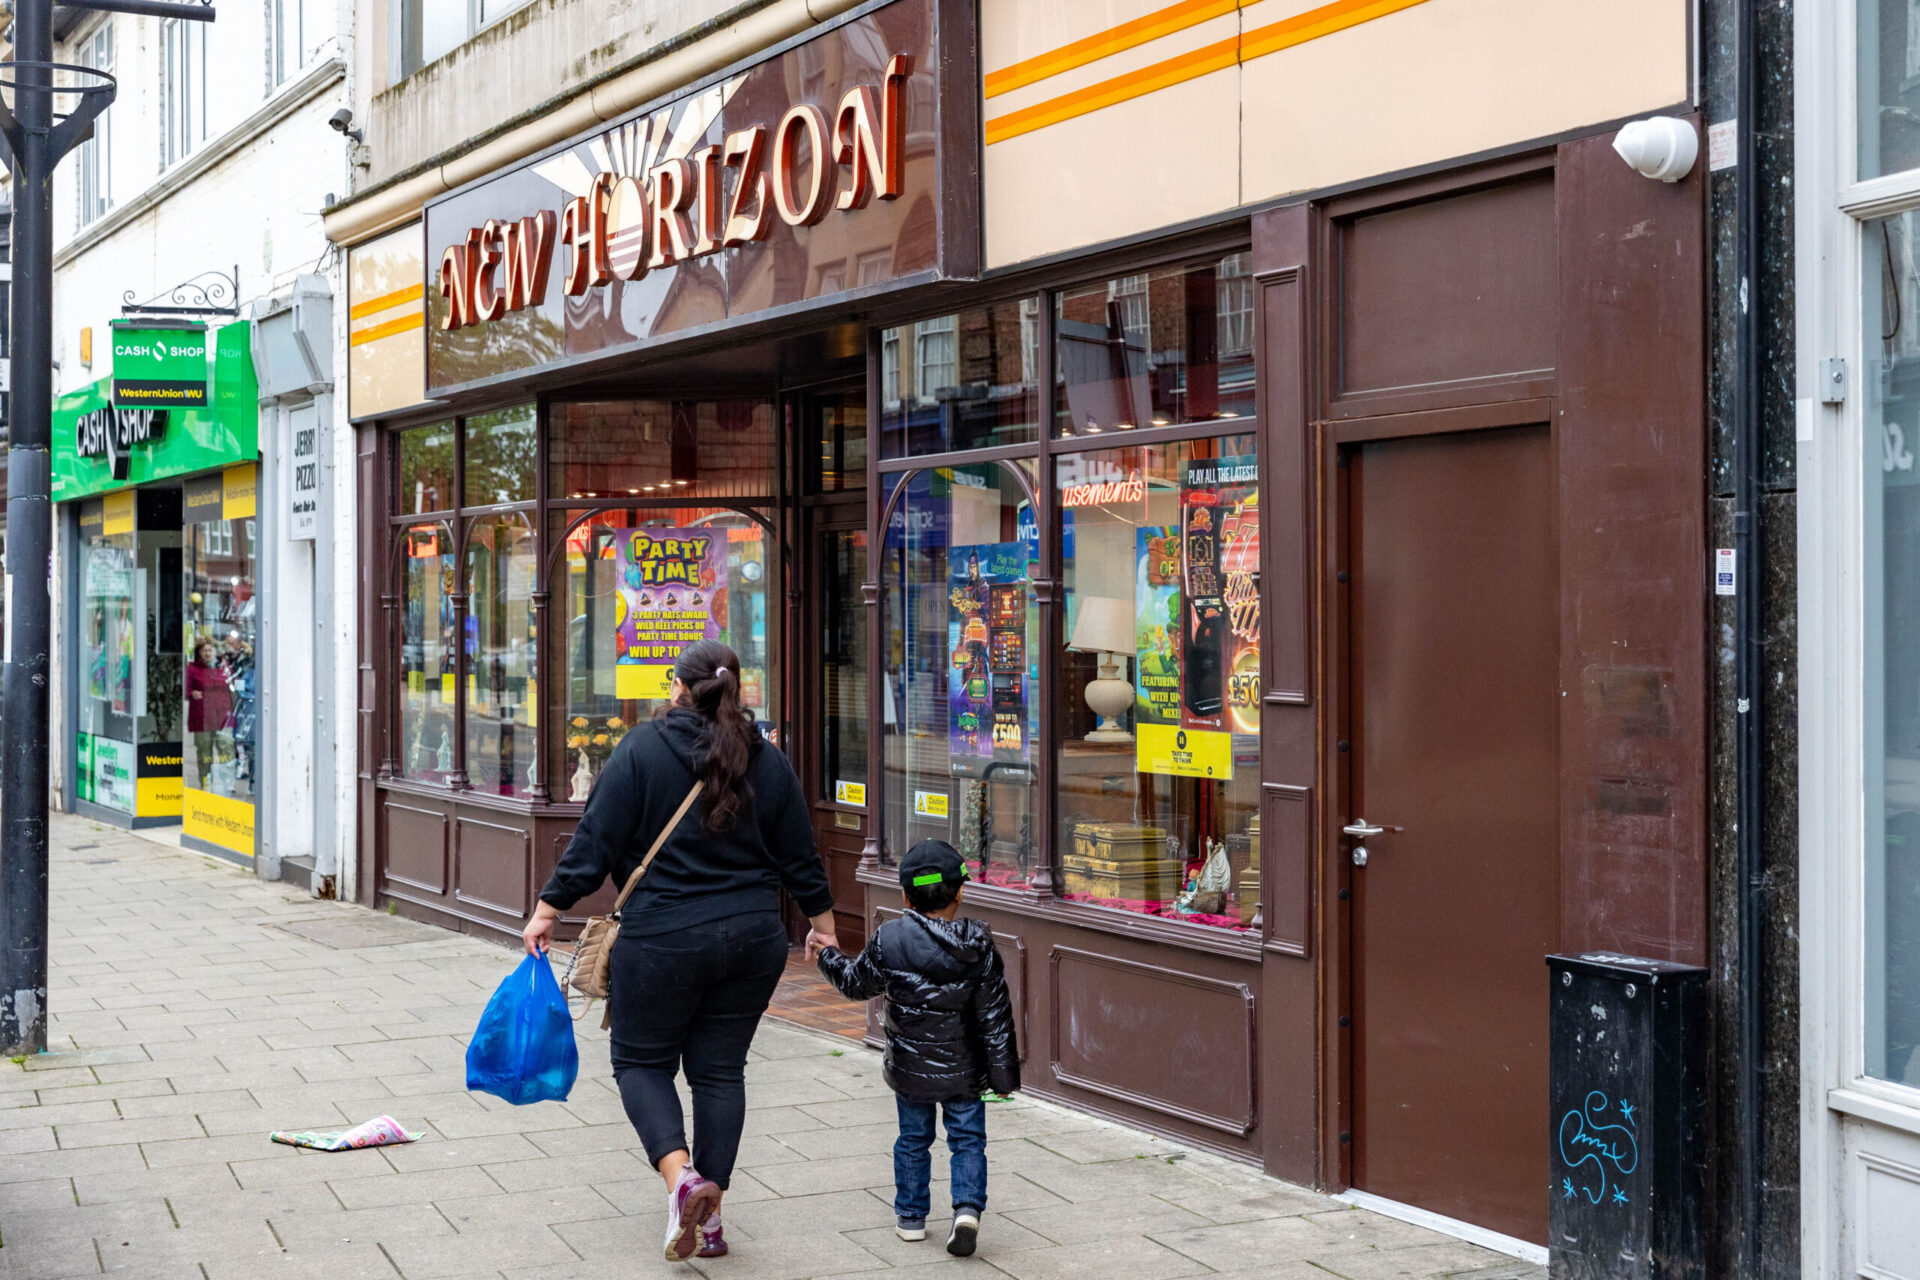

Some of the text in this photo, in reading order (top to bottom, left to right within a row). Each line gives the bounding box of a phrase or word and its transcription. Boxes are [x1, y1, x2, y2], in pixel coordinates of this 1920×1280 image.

[441, 54, 915, 331] NEW HORIZON
[115, 345, 204, 357] CASH SHOP
[119, 388, 184, 399] WesternUnion
[76, 408, 154, 458] CASH SHOP
[295, 428, 315, 457] JERR
[1188, 464, 1255, 485] PLAY ALL THE LATEST
[1062, 471, 1144, 508] usements
[634, 537, 707, 561] PARTY
[997, 554, 1017, 565] Play the
[641, 560, 701, 585] TIME
[991, 564, 1022, 577] latest games
[632, 610, 708, 620] 3 PARTY HATS AWARD
[635, 622, 654, 631] WILD
[655, 622, 671, 631] REEL
[672, 622, 693, 631] PICKS
[637, 632, 703, 641] PARTY TIME BONUS
[629, 645, 681, 658] WIN UP TO
[1150, 691, 1169, 702] WITH
[992, 723, 1022, 750] £500
